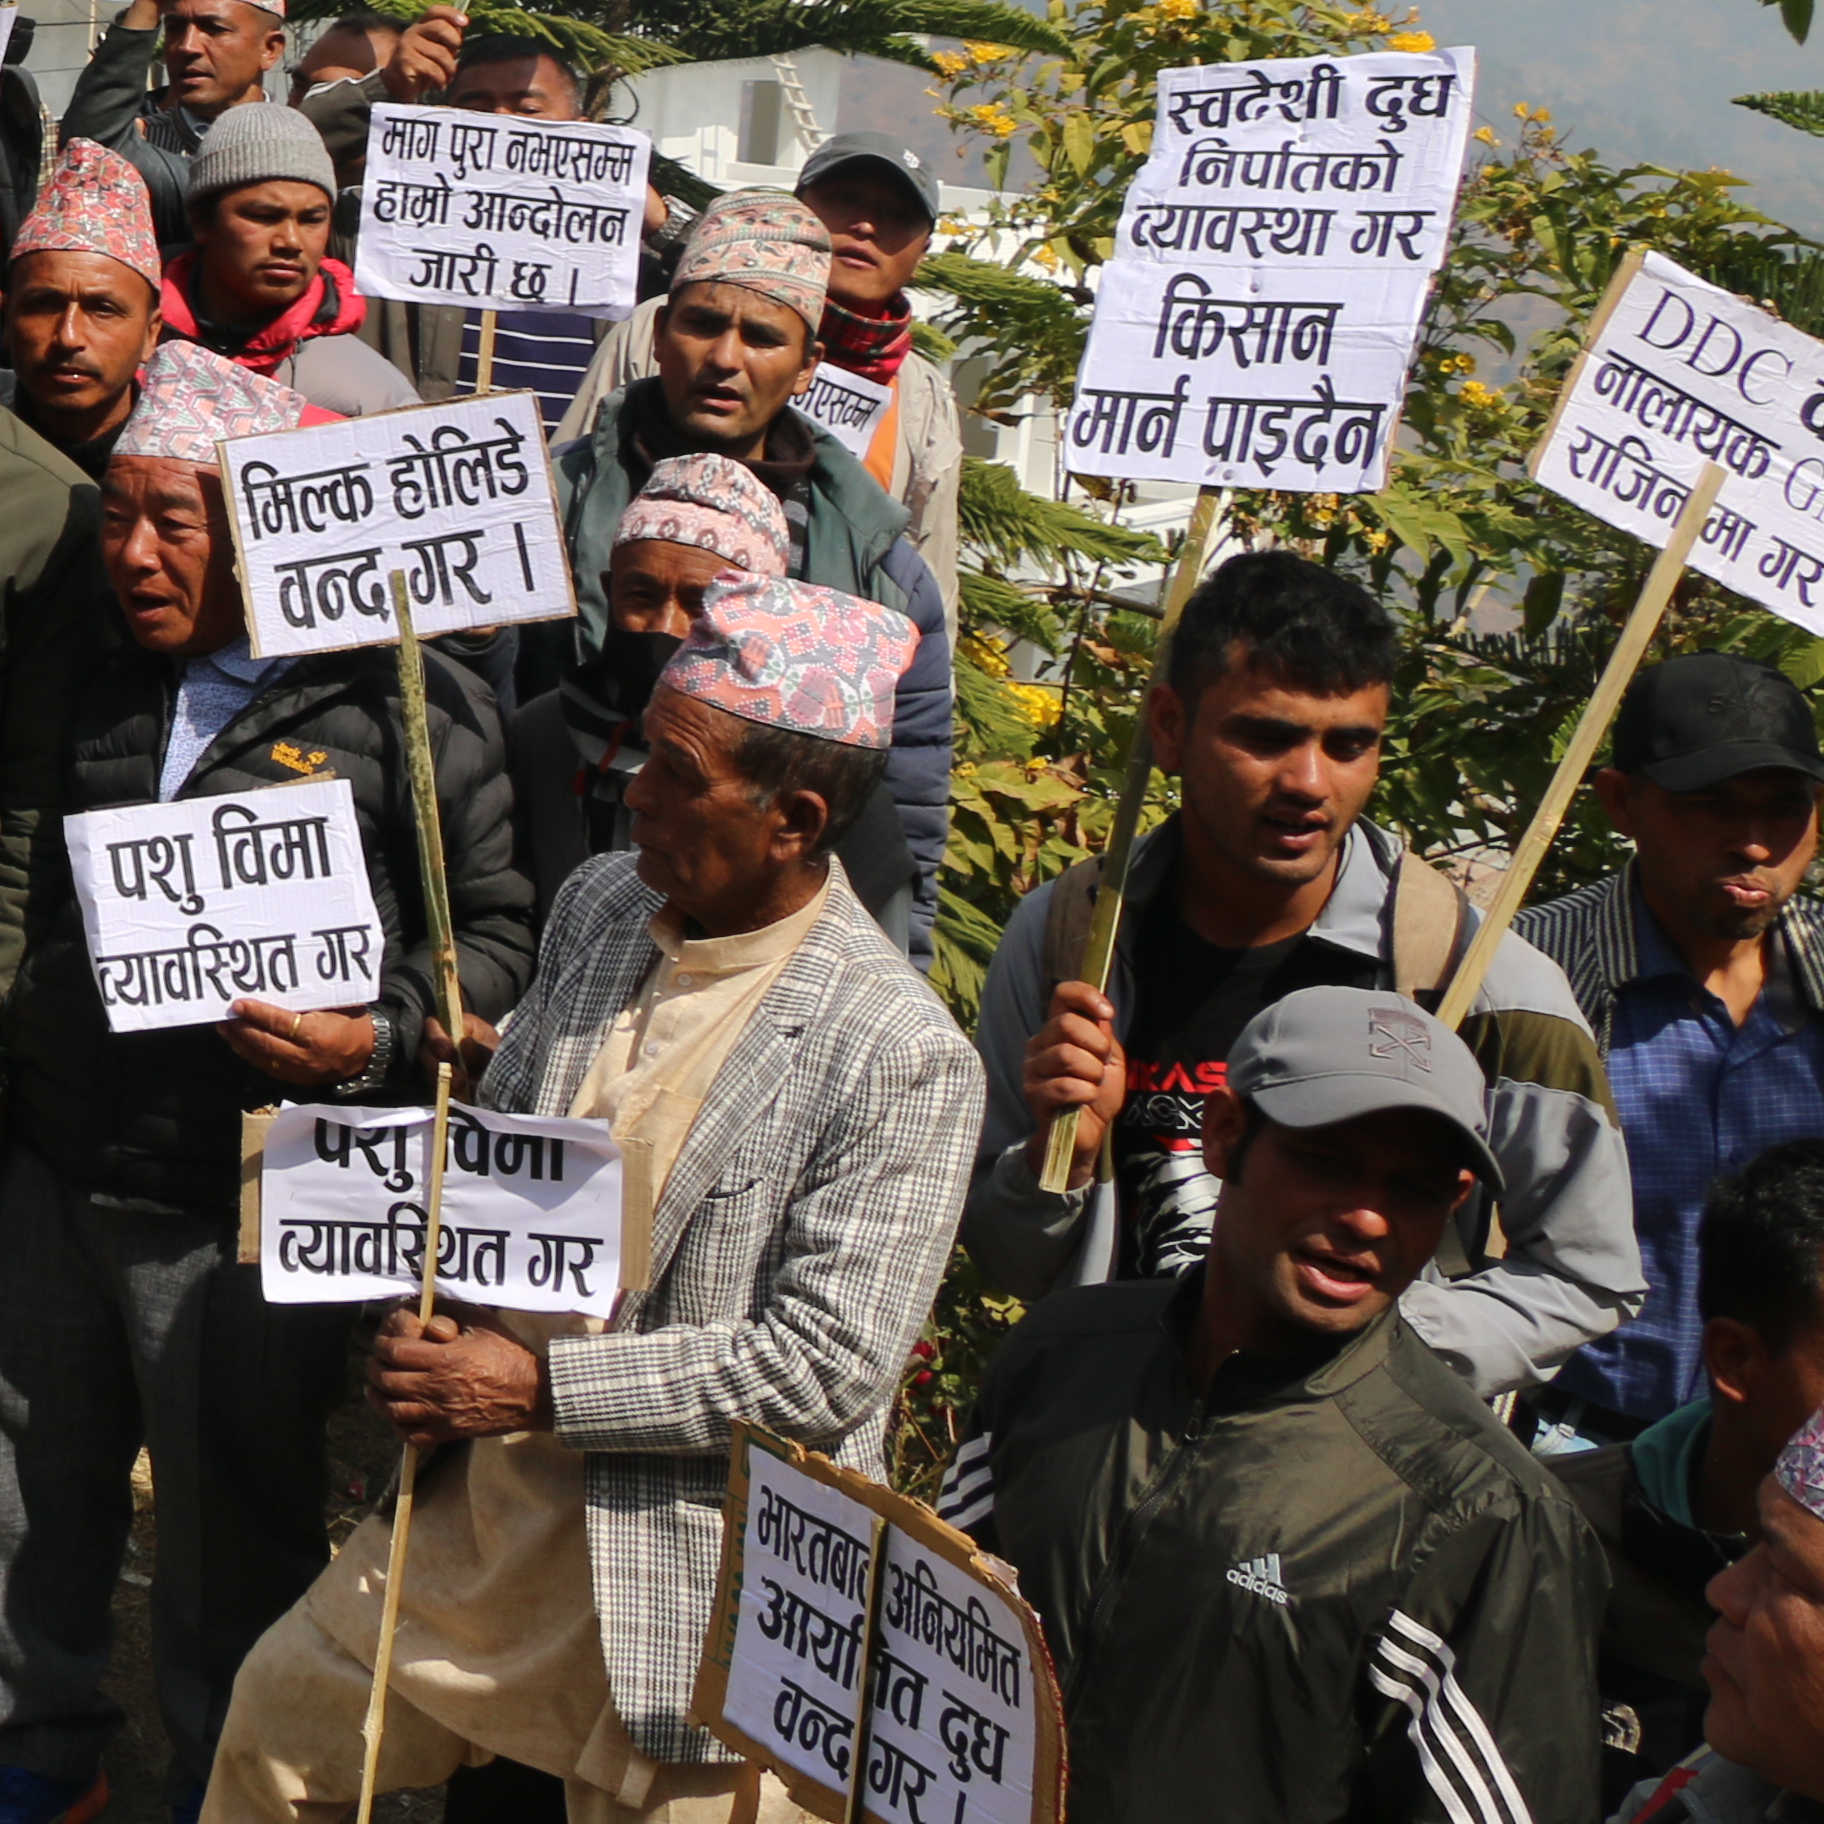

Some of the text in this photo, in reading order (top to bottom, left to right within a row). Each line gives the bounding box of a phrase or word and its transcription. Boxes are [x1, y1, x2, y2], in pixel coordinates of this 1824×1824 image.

[1167, 64, 1456, 135] स्वदेशी दुध
[382, 116, 637, 186] माग पुरा नभएसम्म
[373, 174, 629, 246] हाम्रो आन्दोलन
[1130, 205, 1436, 260] व्यावस्था गर
[409, 242, 550, 304] जारी छ
[1153, 273, 1345, 369] किसान
[1635, 287, 1797, 406] DDC
[1071, 374, 1388, 474] मार्न पाइदैन
[1592, 349, 1783, 481] नालायक
[241, 417, 530, 540] मिल्क होलिडे
[275, 528, 493, 630] वन्द गर
[106, 832, 202, 915] पशु
[96, 923, 375, 1006] व्यावस्थित गर
[527, 1229, 604, 1298] गर
[882, 1546, 1023, 1710] अनियमित
[1226, 1568, 1288, 1605] adidas
[939, 1686, 1010, 1788] दुध
